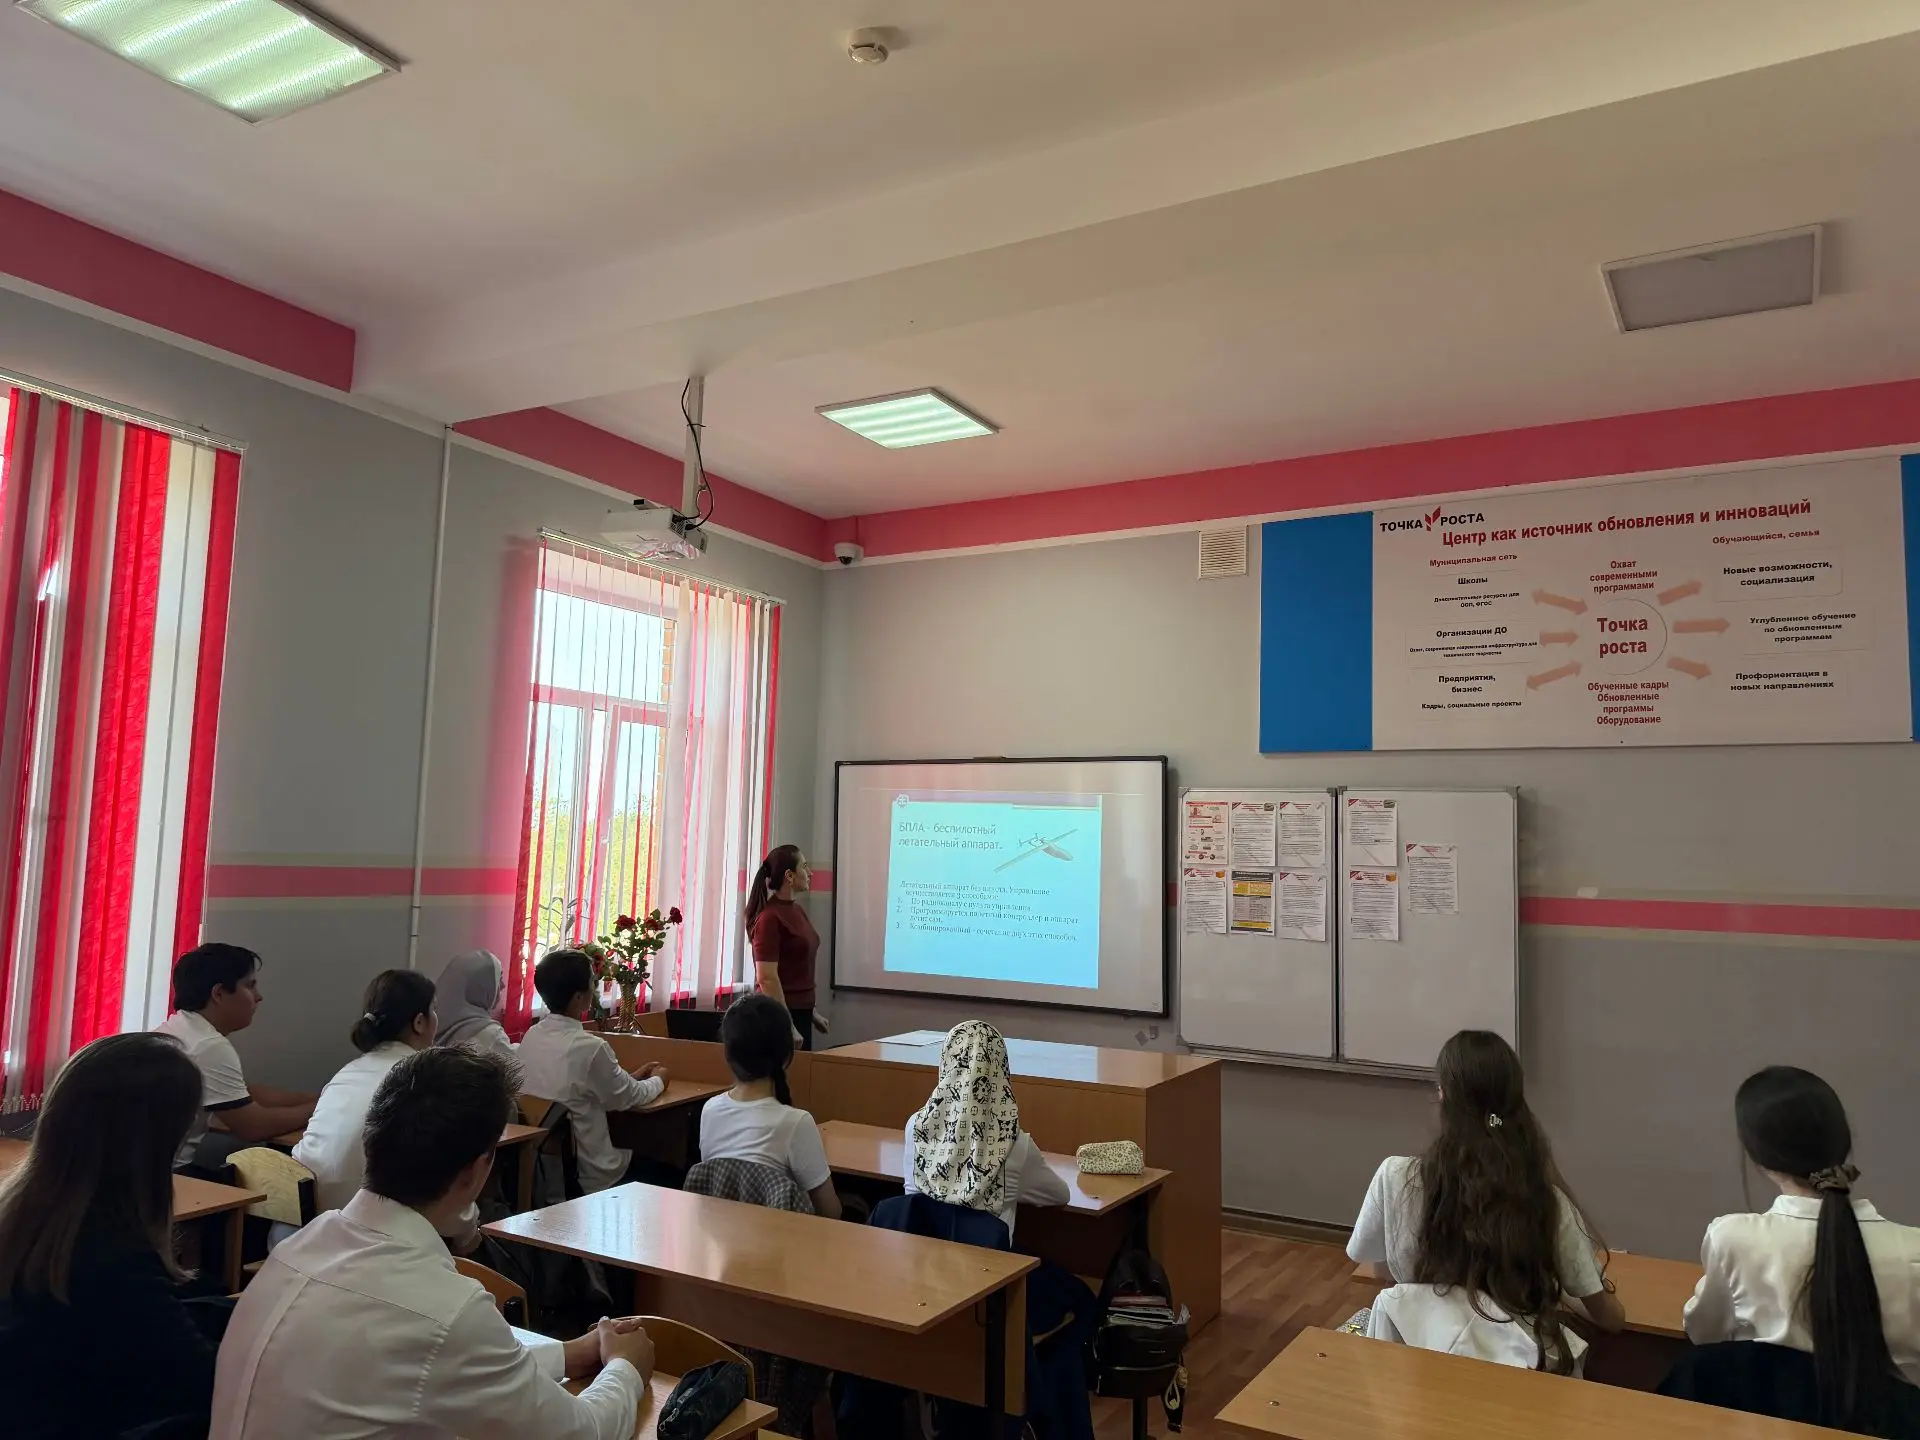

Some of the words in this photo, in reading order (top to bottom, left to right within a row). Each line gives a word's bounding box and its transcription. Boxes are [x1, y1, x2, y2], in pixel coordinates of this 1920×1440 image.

[1380, 519, 1423, 532] ТОЧКА
[1440, 512, 1484, 526] РОСТА
[1442, 530, 1486, 547] Центр
[1491, 528, 1516, 542] как
[1521, 522, 1593, 538] источник
[1597, 512, 1694, 532] обновления
[1700, 511, 1710, 522] и
[1716, 498, 1810, 522] инноваций
[1712, 532, 1786, 544] Обучающийся,
[1788, 530, 1820, 538] семья
[1430, 555, 1496, 568] Муниципальная
[1610, 560, 1636, 569] Охват
[1724, 566, 1756, 574] Новые
[1759, 562, 1832, 572] возможности,
[1458, 577, 1488, 585] Школы
[1590, 570, 1658, 582] современными
[1740, 575, 1814, 586] социализация
[1594, 582, 1654, 594] программами
[1750, 616, 1810, 624] Углубленное
[1812, 613, 1856, 622] обучение
[1597, 618, 1648, 632] Точка
[1778, 624, 1842, 632] обновленным
[1436, 628, 1492, 638] Организации
[1494, 626, 1508, 635] ДО
[1774, 634, 1832, 643] программам
[1600, 641, 1647, 658] роста
[1438, 674, 1496, 683] Предприятия,
[1736, 670, 1820, 680] Профориентация
[1588, 682, 1638, 692] Обученные
[1640, 680, 1669, 690] кадры
[1764, 681, 1834, 690] направлениях
[1598, 693, 1660, 702] Обновленные
[1603, 705, 1654, 714] программы
[1597, 716, 1661, 726] Оборудование
[899, 822, 924, 832] БПЛА
[934, 822, 996, 835] беспилотный
[898, 838, 959, 848] летательный
[961, 840, 1002, 850] аппарат.
